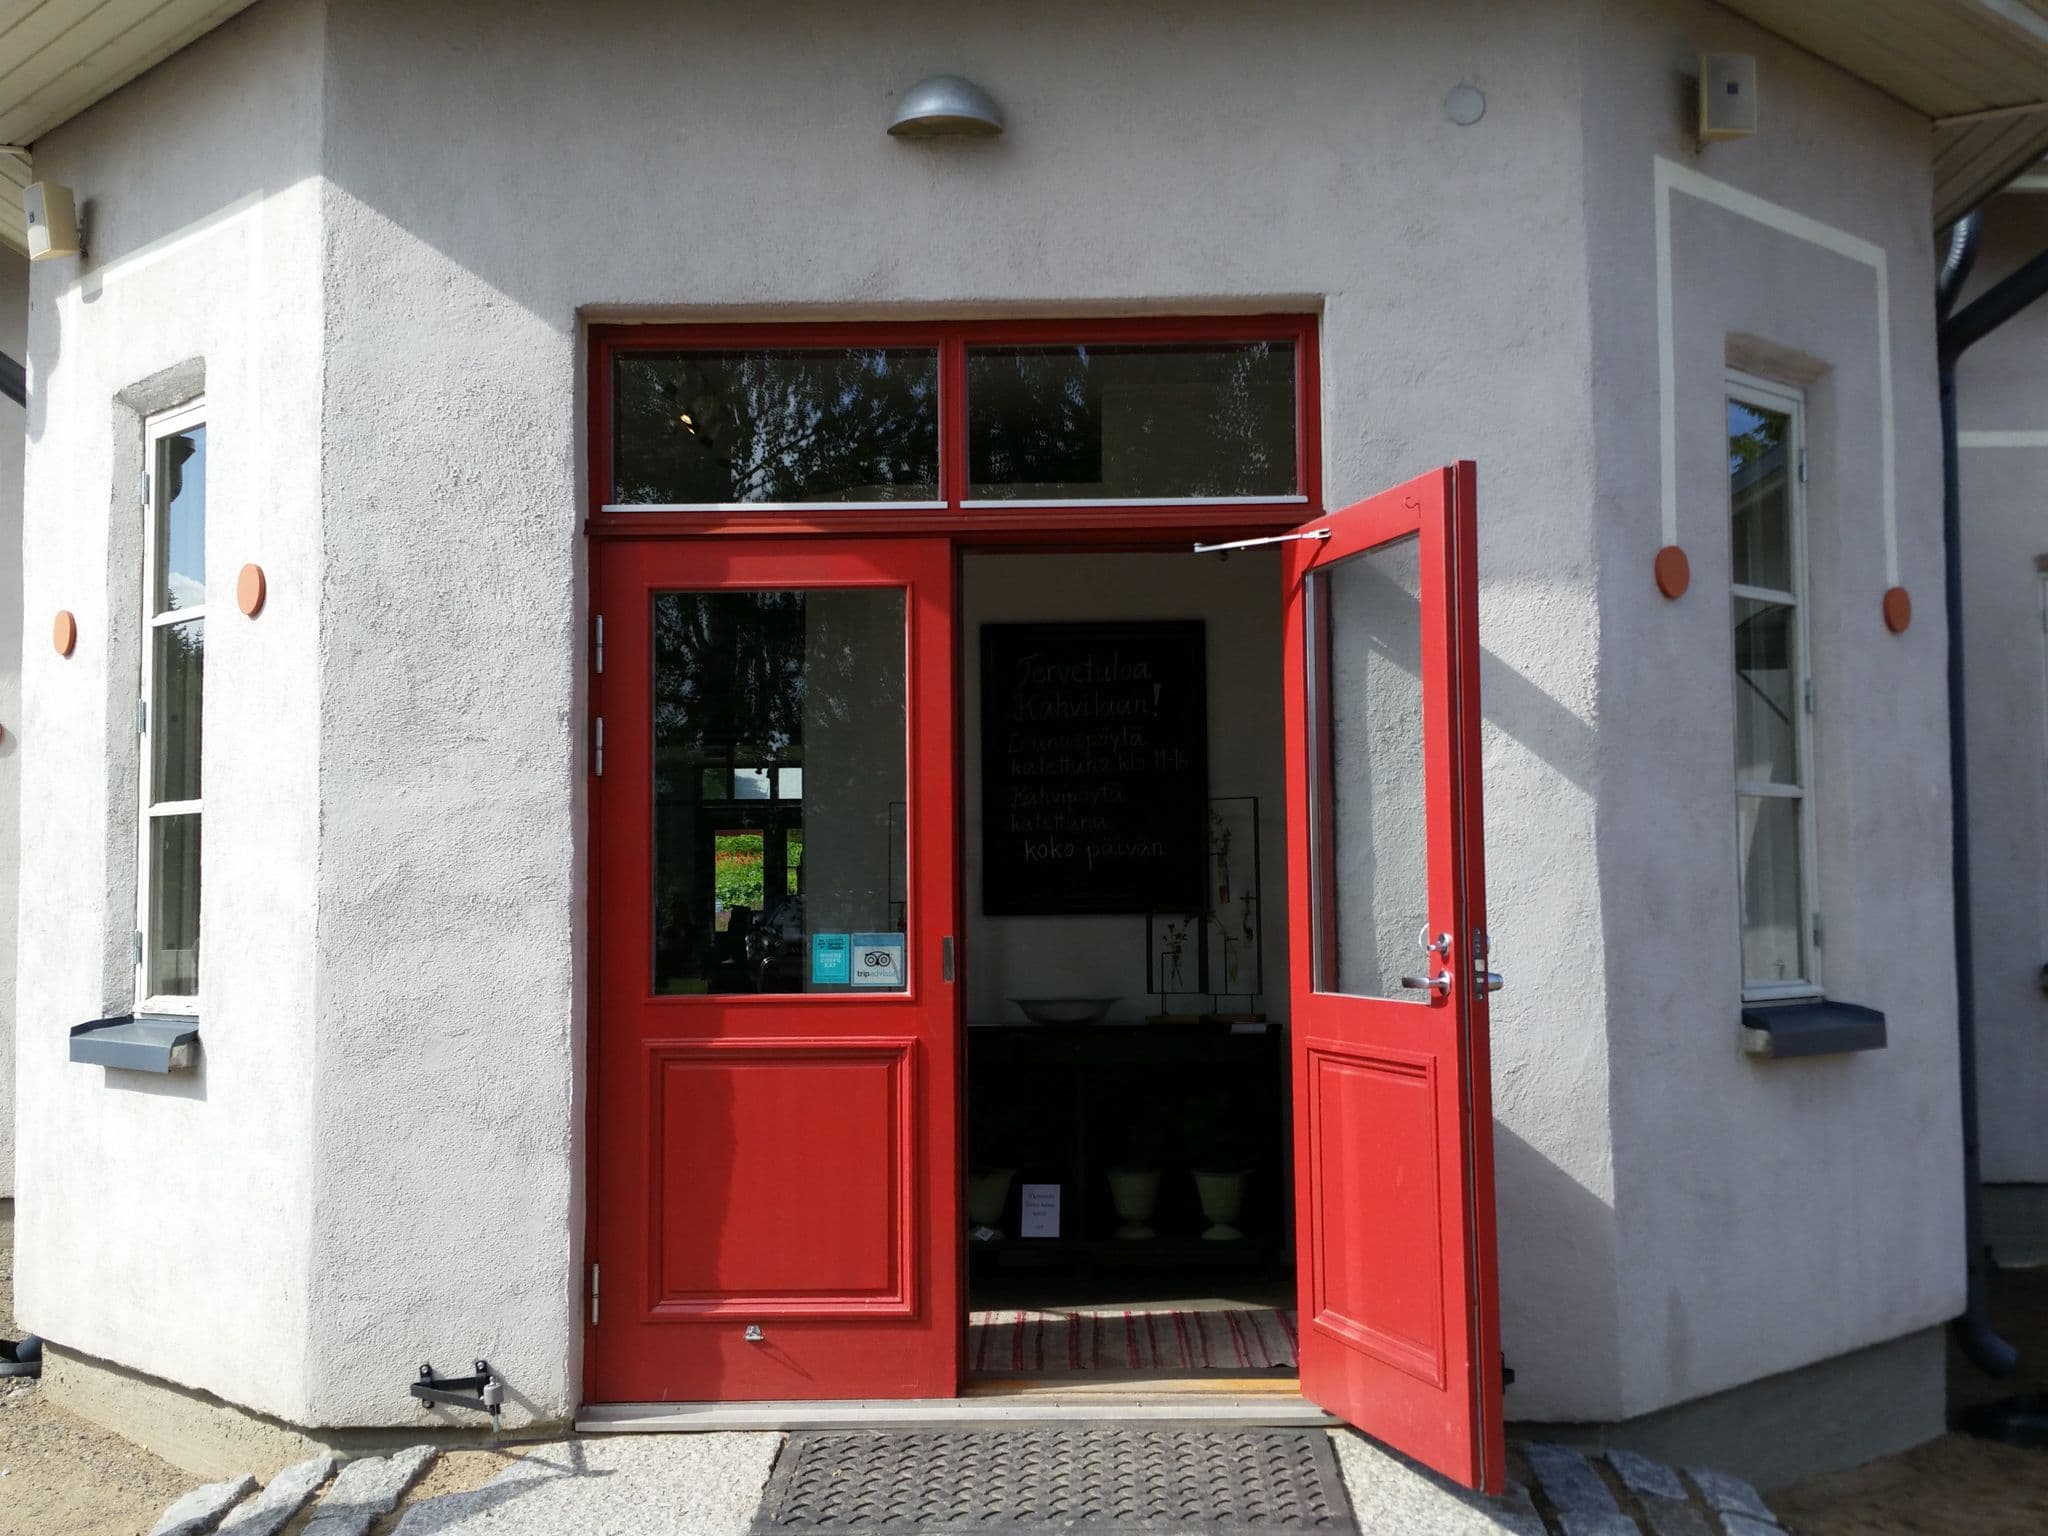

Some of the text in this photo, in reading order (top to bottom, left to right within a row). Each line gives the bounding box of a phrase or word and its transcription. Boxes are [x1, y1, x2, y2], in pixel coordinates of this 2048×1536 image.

[1017, 650, 1152, 687] Tervetuloa
[1014, 684, 1162, 720] Kahvilaan!
[1007, 727, 1146, 755] Lunapöytä
[1009, 784, 1124, 812] Kahvipytä
[1024, 836, 1075, 862] koko
